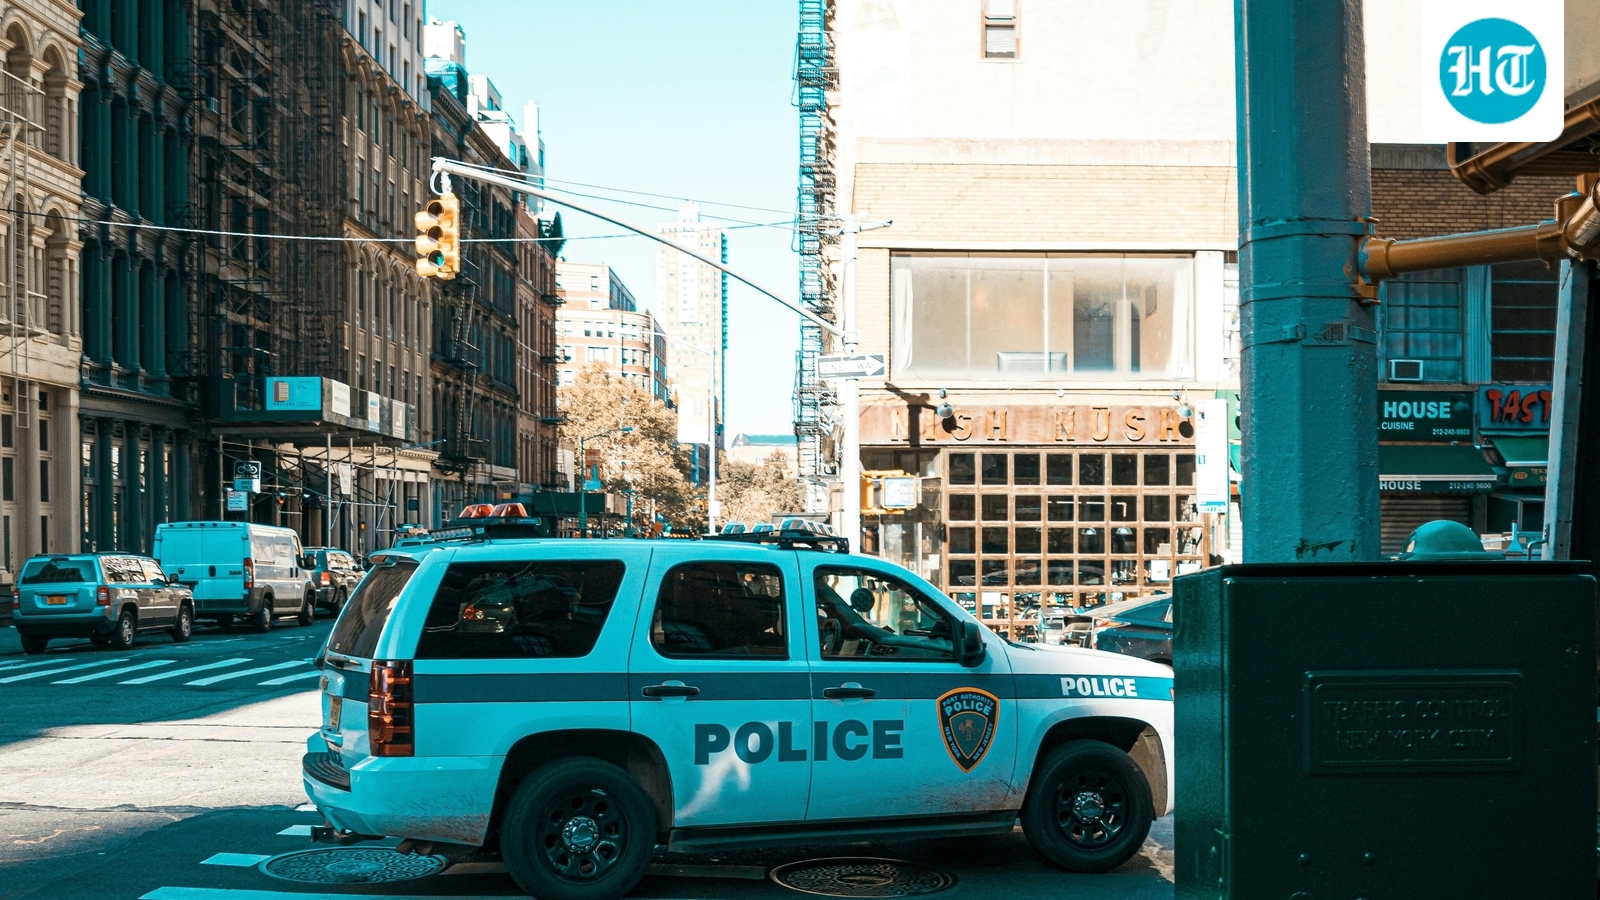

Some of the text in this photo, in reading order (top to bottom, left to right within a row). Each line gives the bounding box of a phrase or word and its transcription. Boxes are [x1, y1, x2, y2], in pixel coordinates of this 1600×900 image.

[824, 361, 876, 373] ONE WAY
[1384, 401, 1451, 419] HOUSE
[1487, 389, 1553, 423] TAST
[890, 408, 1008, 442] NISH
[1381, 421, 1414, 430] CUISINE
[1380, 480, 1421, 490] HOUSE
[1060, 676, 1137, 697] POLICE
[943, 693, 995, 706] PORT AUTHORITY
[944, 700, 992, 716] POLICE
[1323, 698, 1508, 722] TRAFFIC CONTROL
[693, 719, 904, 766] POLICE
[944, 726, 961, 758] NEW YORK
[973, 723, 993, 760] NEW JERSEY
[1335, 728, 1495, 749] NEW YORK CITY
